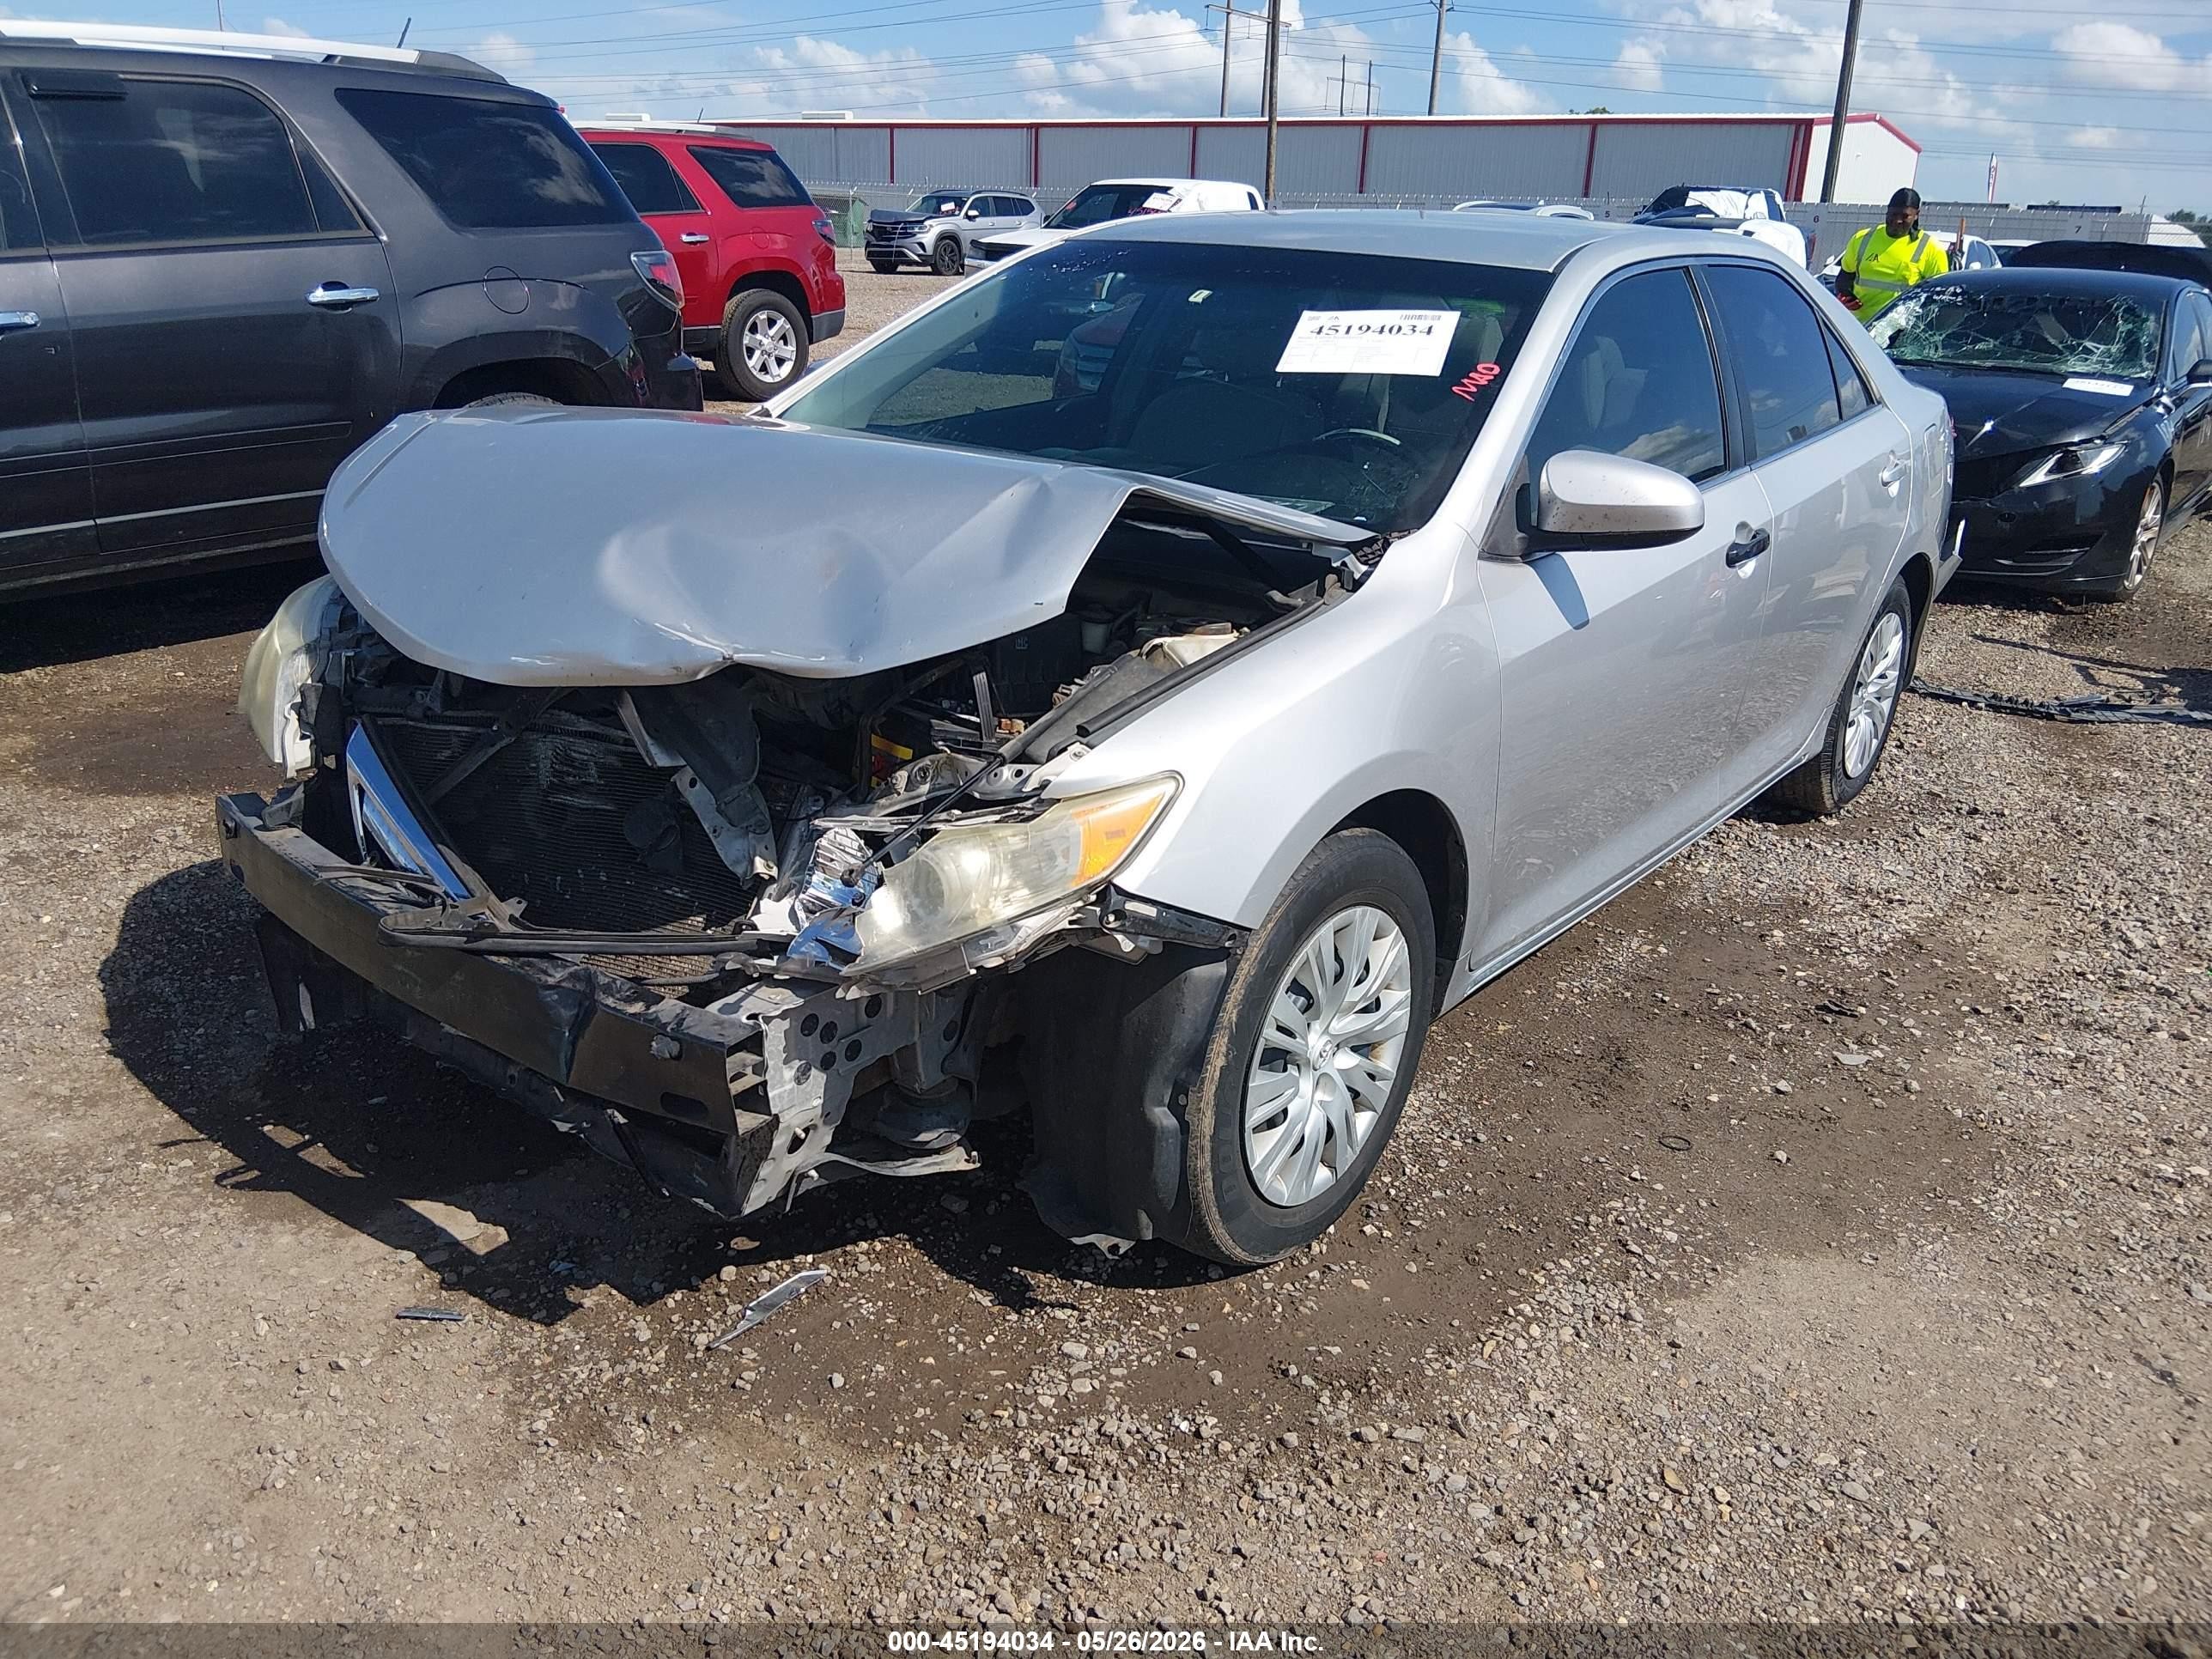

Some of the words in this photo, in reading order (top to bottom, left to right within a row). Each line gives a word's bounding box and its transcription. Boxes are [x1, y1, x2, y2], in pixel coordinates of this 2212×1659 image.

[1813, 215, 1820, 223] 6
[2075, 225, 2082, 234] 7
[1310, 324, 1435, 337] 45194034
